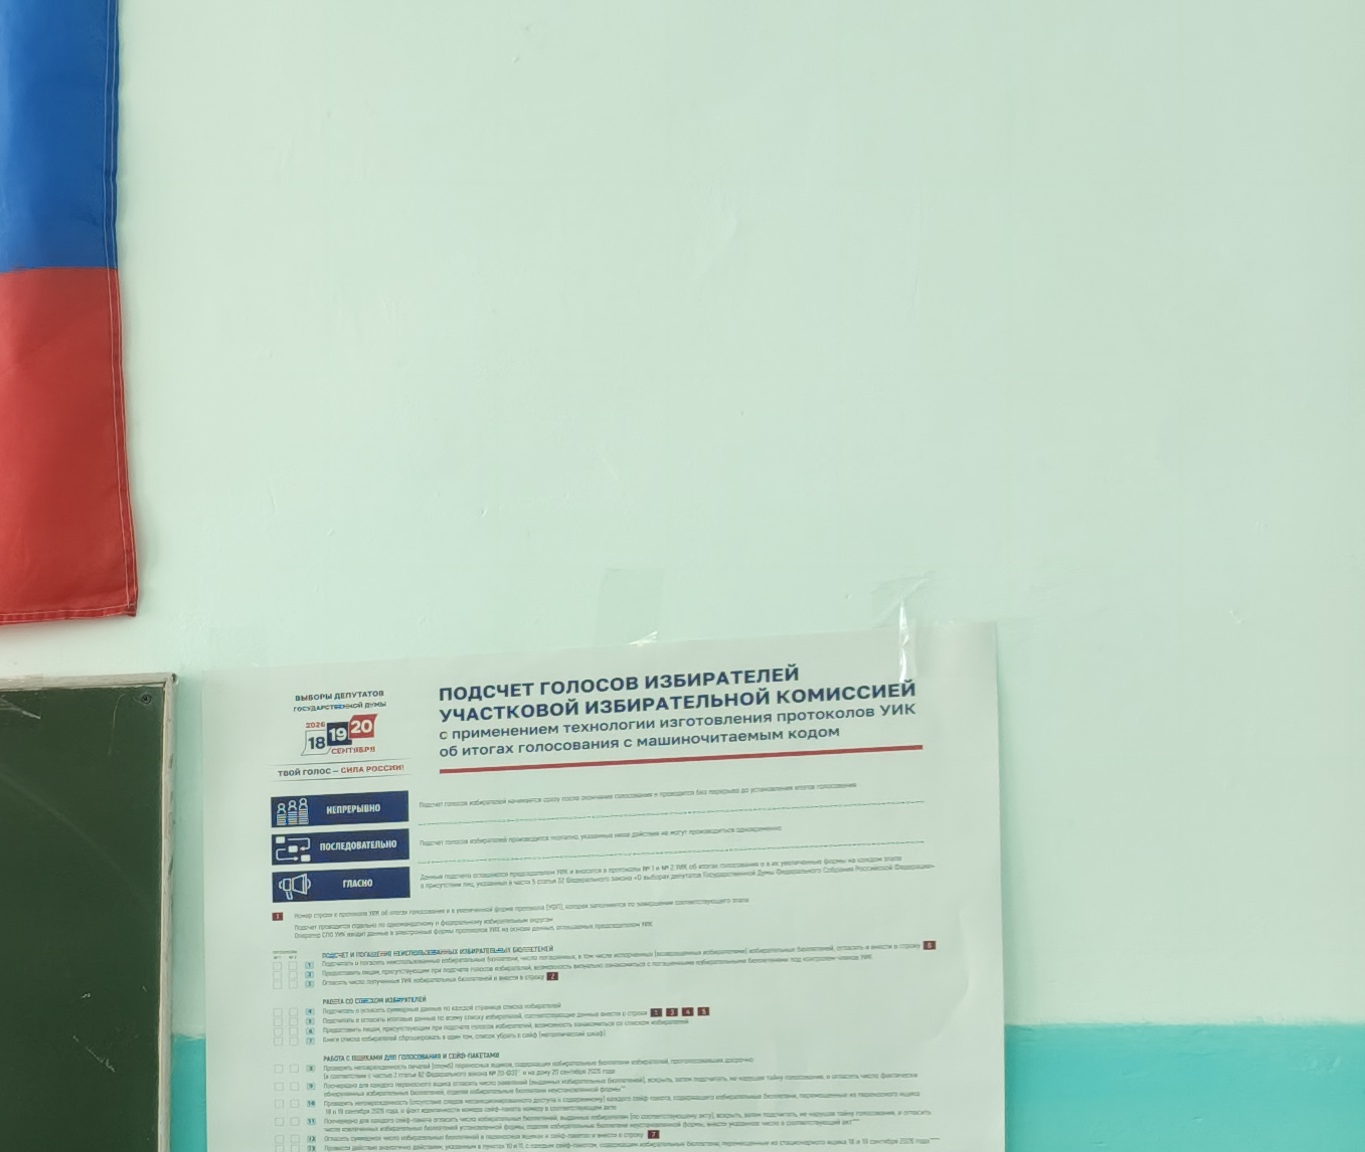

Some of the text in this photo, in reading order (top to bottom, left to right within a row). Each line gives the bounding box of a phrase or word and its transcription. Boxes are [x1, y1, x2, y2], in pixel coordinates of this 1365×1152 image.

[440, 663, 799, 702] ПОДСЧЕТ ГОЛОСОВ ИЗБИРАТЕЛЕЙ
[334, 691, 384, 700] ДЕПУТАТОВ
[440, 679, 916, 722] УЧАСТКОВОЙ ИЗБИРАТЕЛЬНОЙ КОМИССИЕЙ
[440, 703, 916, 741] с применением технологии изготовления протоколов УИК
[309, 720, 372, 749] 18 19 20
[440, 728, 840, 757] об итогах голосования с машиночитаемым кодом
[278, 768, 300, 776] ТВОЙ
[326, 804, 381, 815] НЕПРЕРЫВНО
[320, 840, 397, 851] ПОСЛЕДОВАТЕЛЬНО
[343, 879, 373, 888] ГЛАСНО
